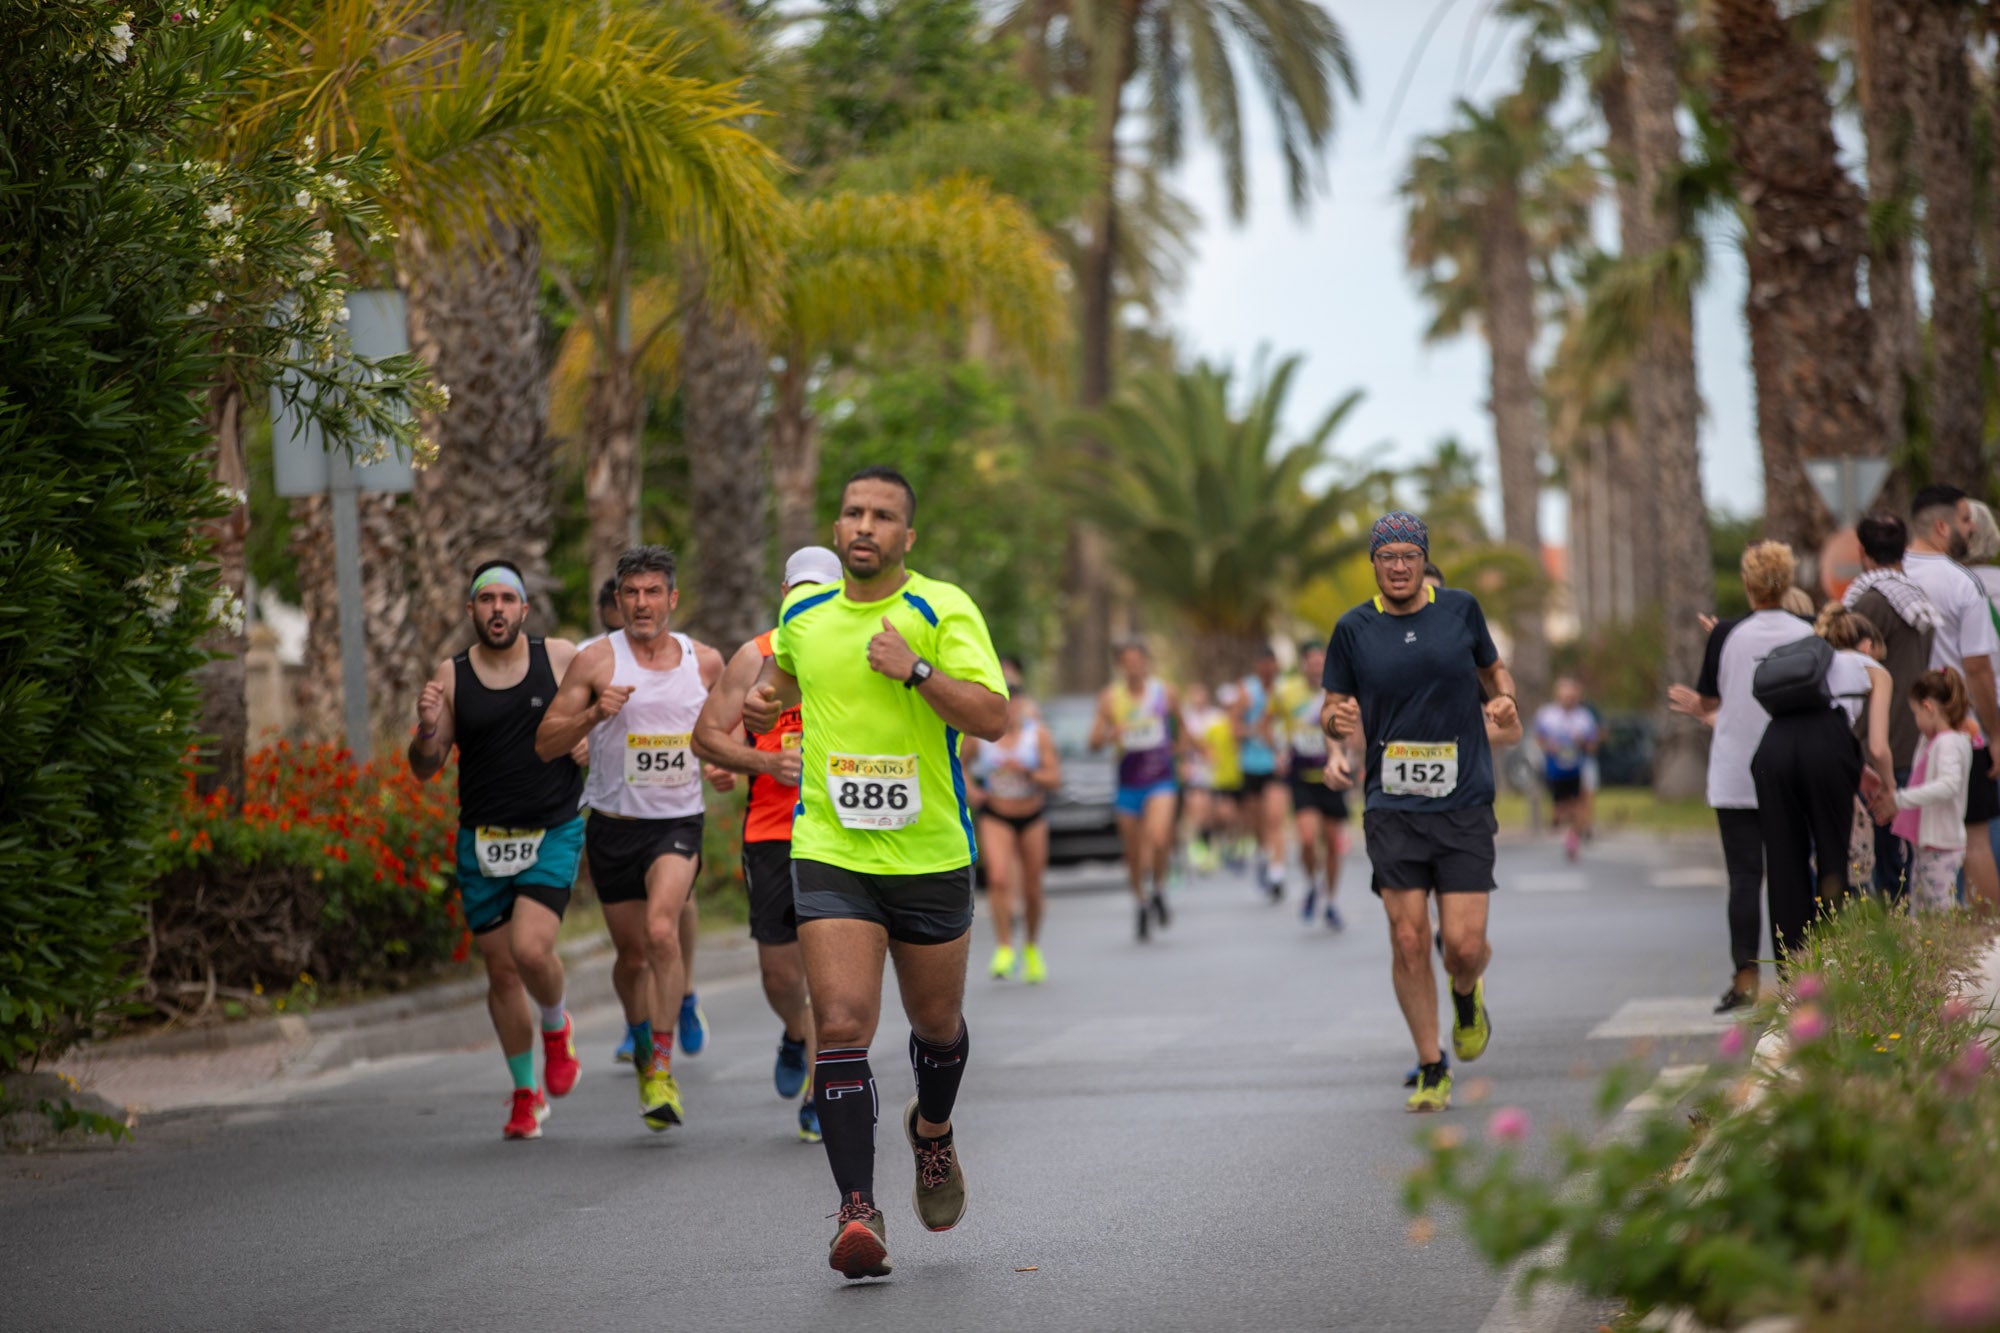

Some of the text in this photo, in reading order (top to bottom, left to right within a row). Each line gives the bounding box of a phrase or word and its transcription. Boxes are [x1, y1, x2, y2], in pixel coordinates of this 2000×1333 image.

[637, 751, 685, 771] 954
[840, 758, 855, 772] 38
[1395, 762, 1445, 784] 152
[839, 782, 908, 810] 886
[487, 843, 533, 863] 958
